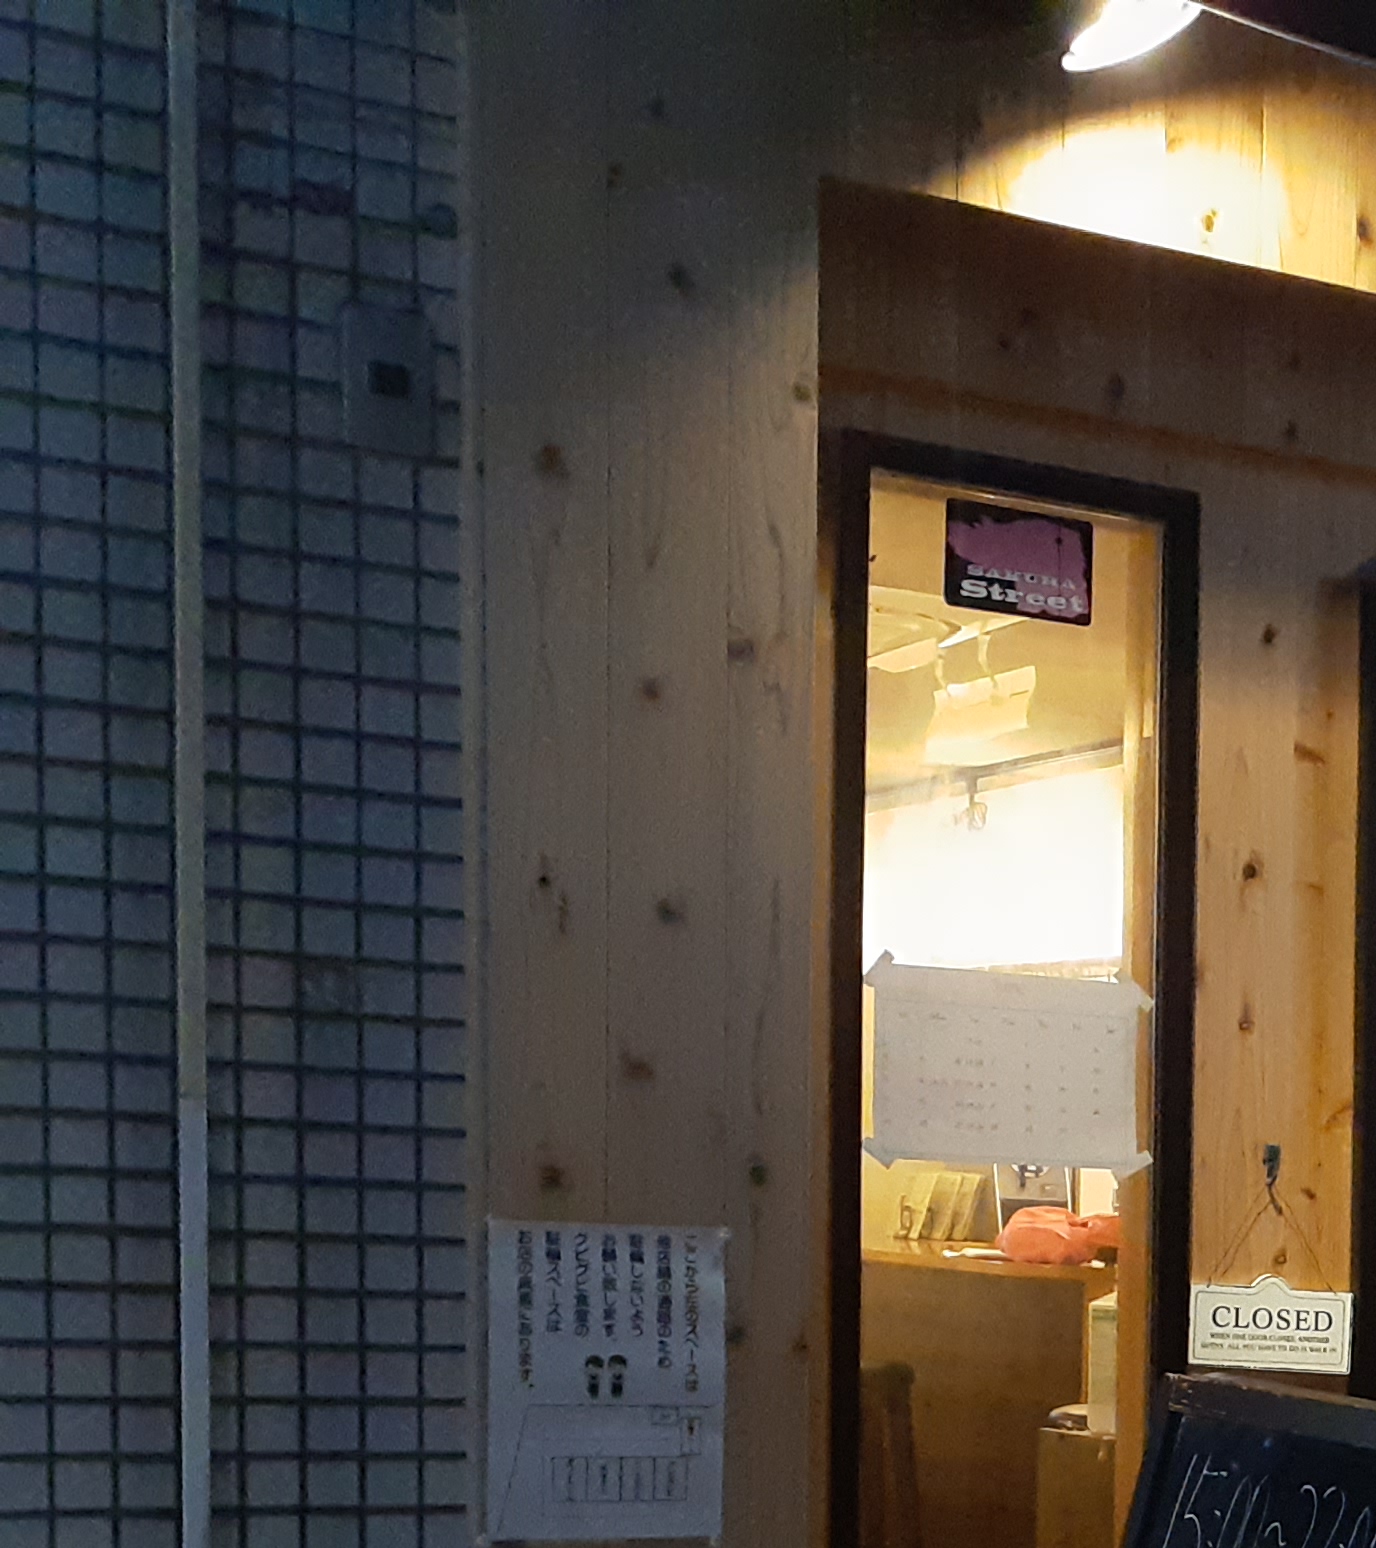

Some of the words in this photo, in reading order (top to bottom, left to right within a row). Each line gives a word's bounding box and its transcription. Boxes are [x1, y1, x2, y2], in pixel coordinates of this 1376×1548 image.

[967, 564, 1076, 591] SAKURA
[959, 579, 1084, 613] Street
[1211, 1306, 1333, 1332] CLOSED
